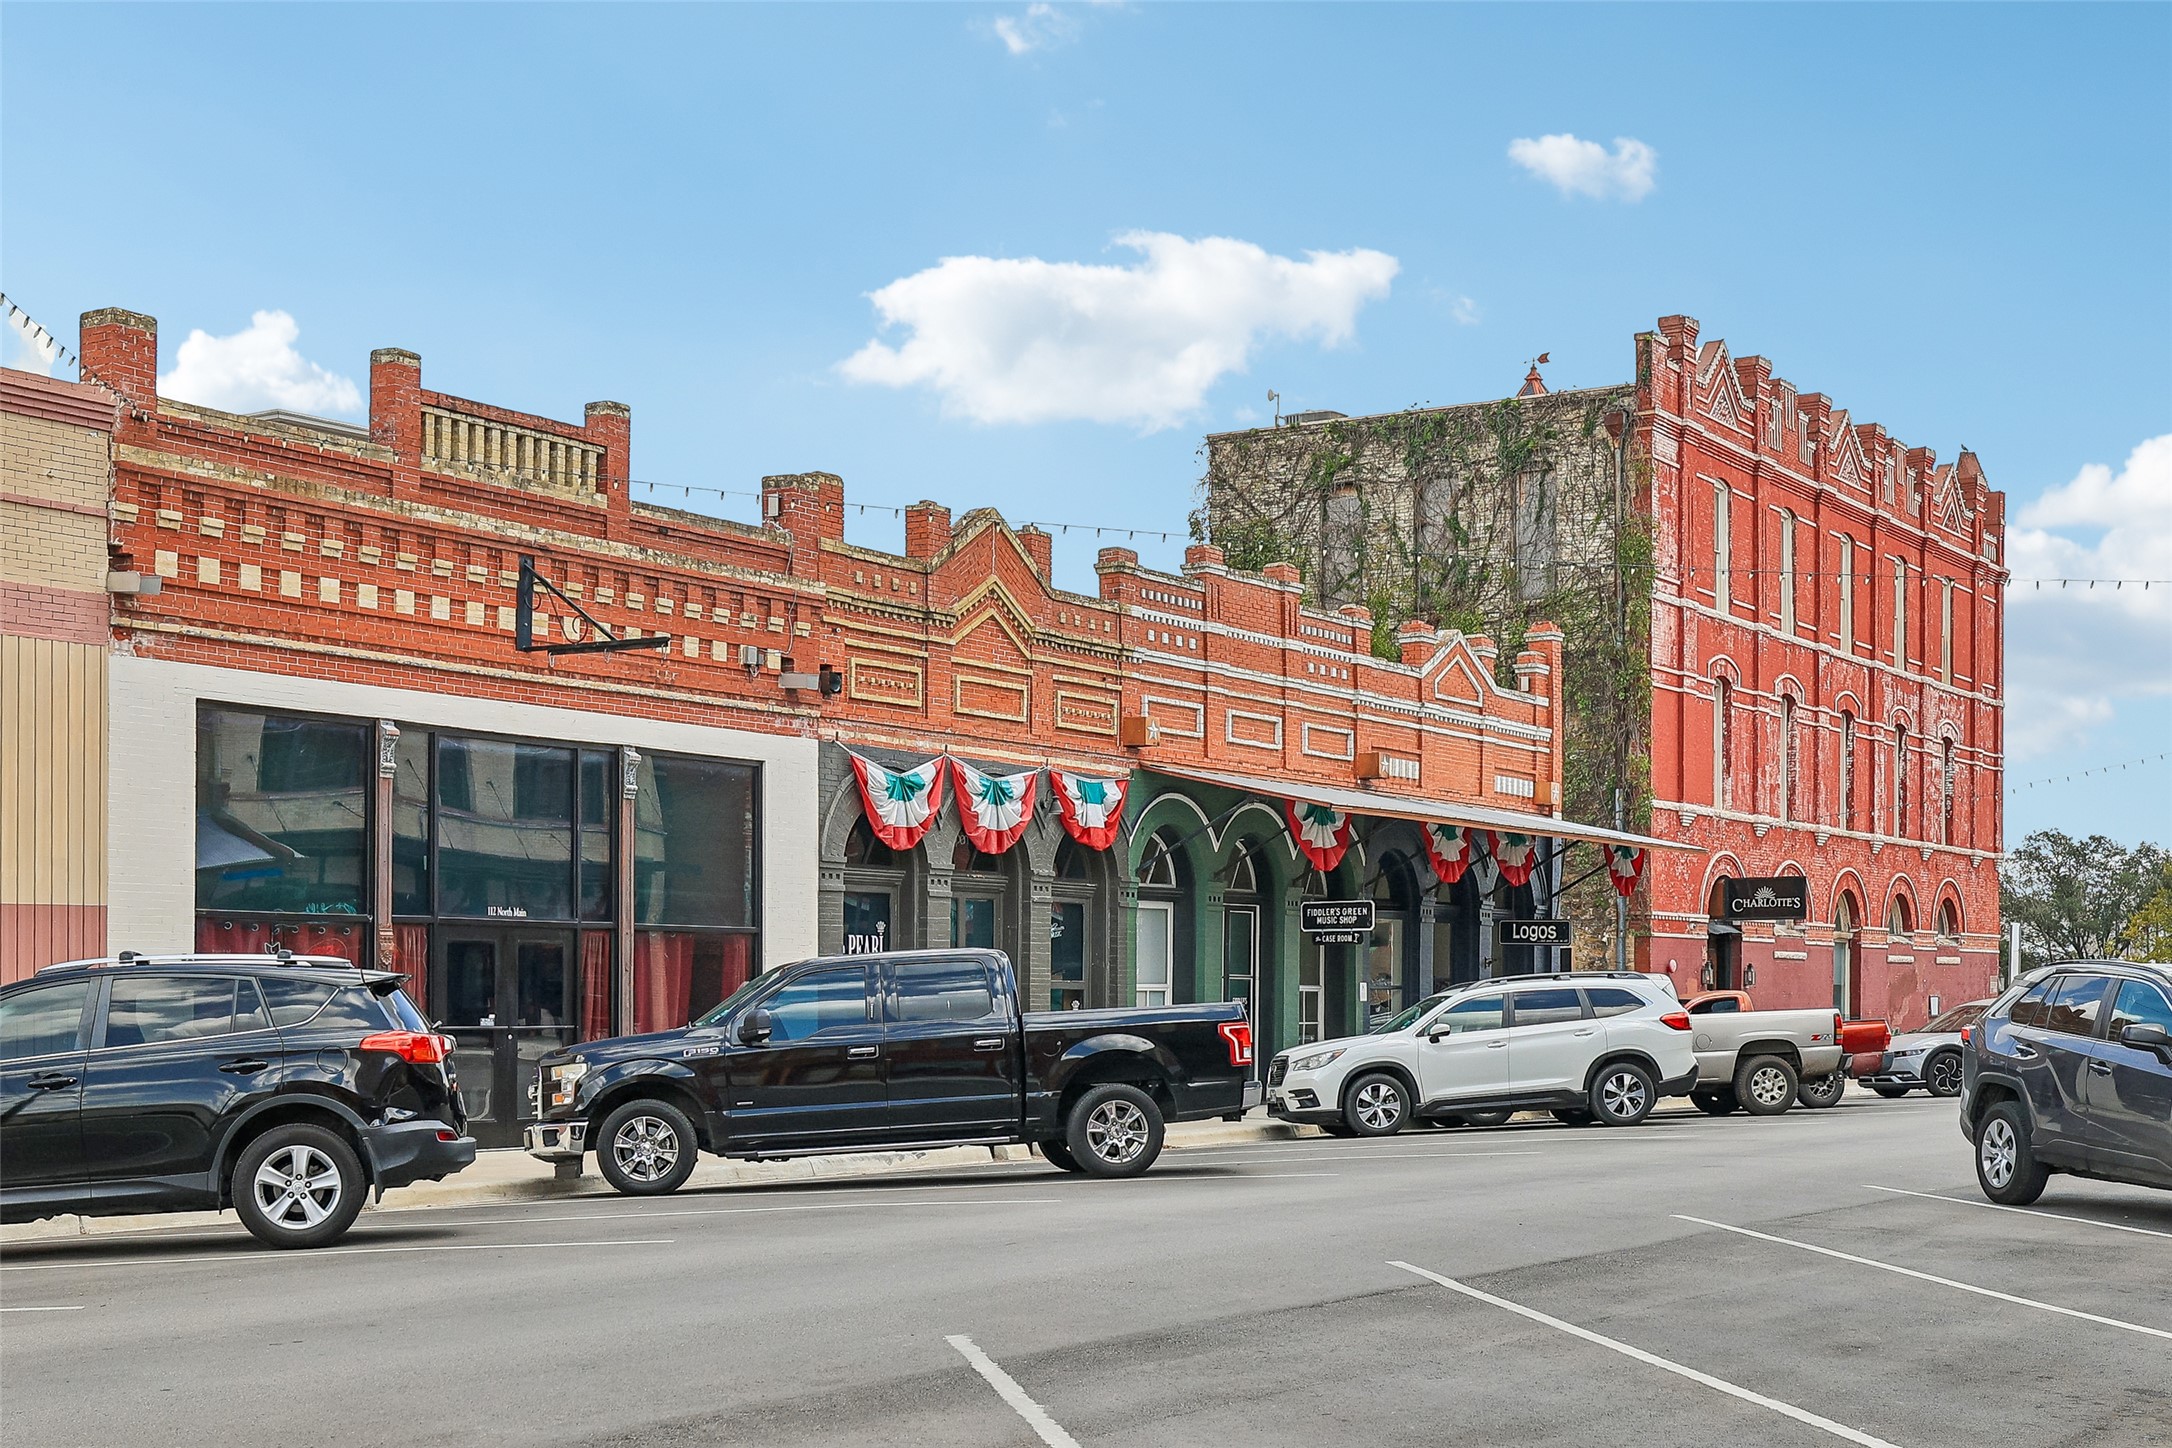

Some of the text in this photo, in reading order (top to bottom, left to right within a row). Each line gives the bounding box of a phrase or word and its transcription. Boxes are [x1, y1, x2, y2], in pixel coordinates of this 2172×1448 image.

[1732, 897, 1801, 912] CHARLOTTE'S
[488, 906, 527, 917] 112 North Main
[1307, 907, 1368, 917] FIDDLER'S GREEN
[1317, 916, 1357, 925] MUSIC SHOP
[1513, 923, 1557, 941] Logos
[1337, 934, 1353, 942] ROOM
